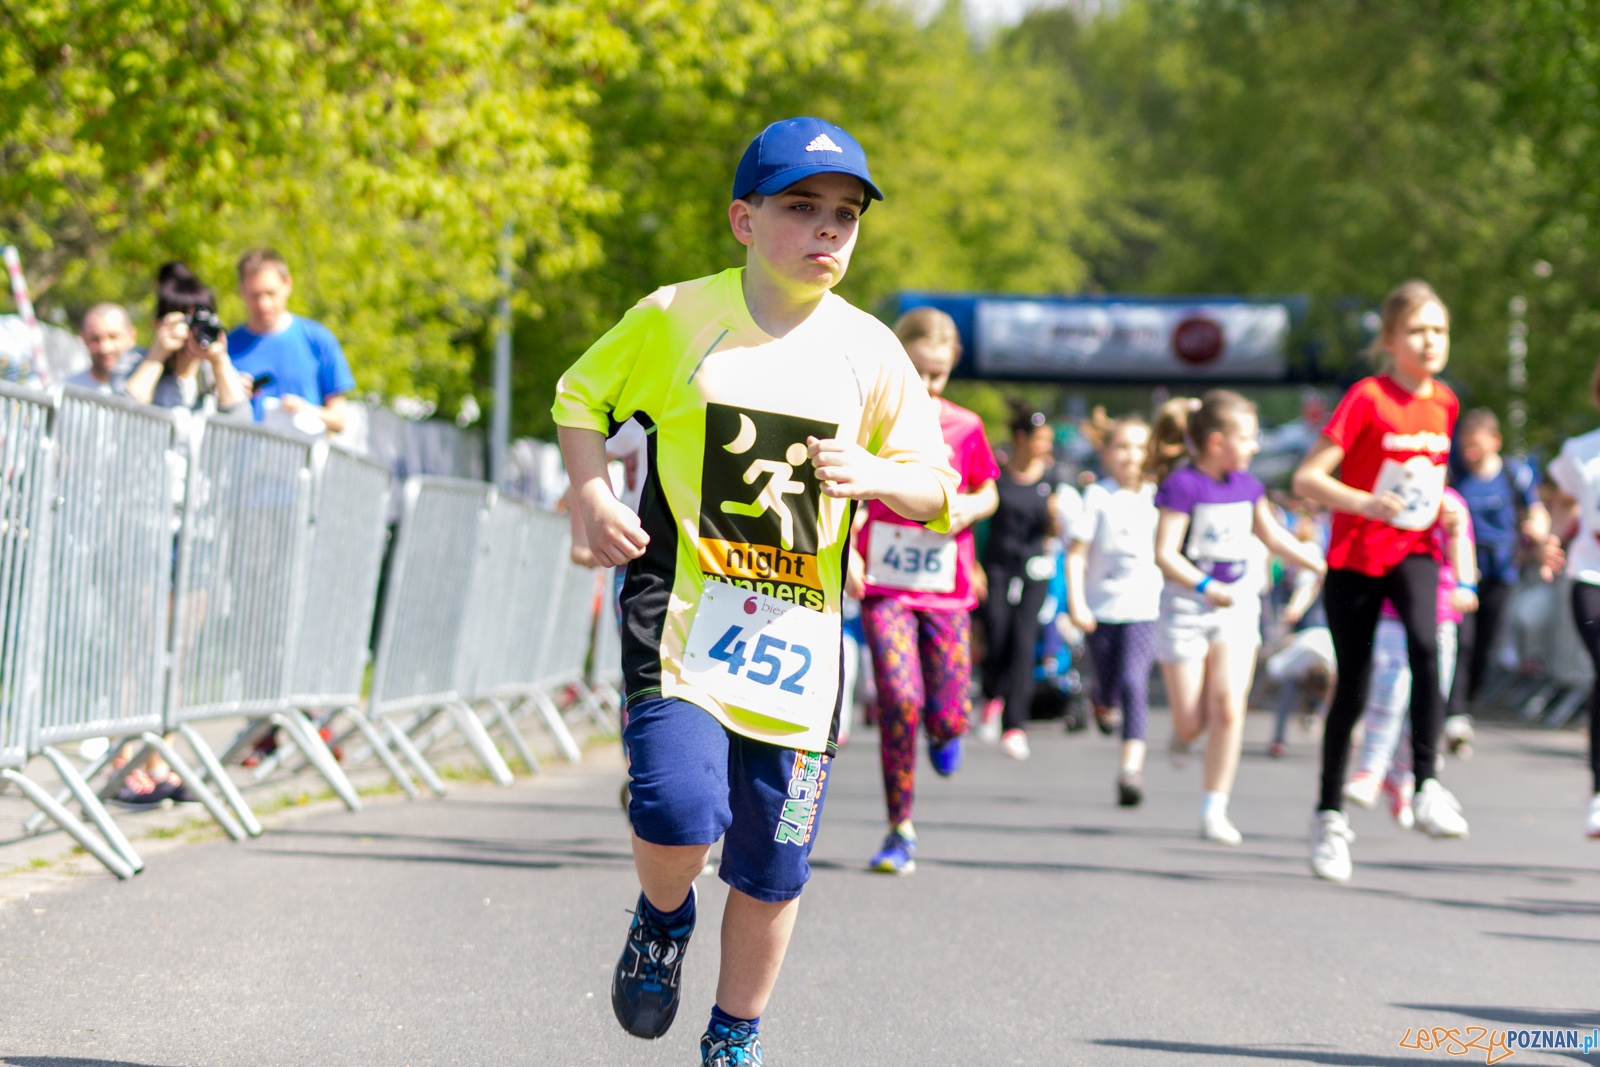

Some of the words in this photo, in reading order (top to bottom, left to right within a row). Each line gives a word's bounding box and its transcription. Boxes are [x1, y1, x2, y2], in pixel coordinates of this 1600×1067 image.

[726, 544, 805, 578] night
[882, 545, 941, 573] 436
[704, 572, 823, 611] nners
[708, 624, 812, 696] 452
[775, 779, 817, 846] CWZ
